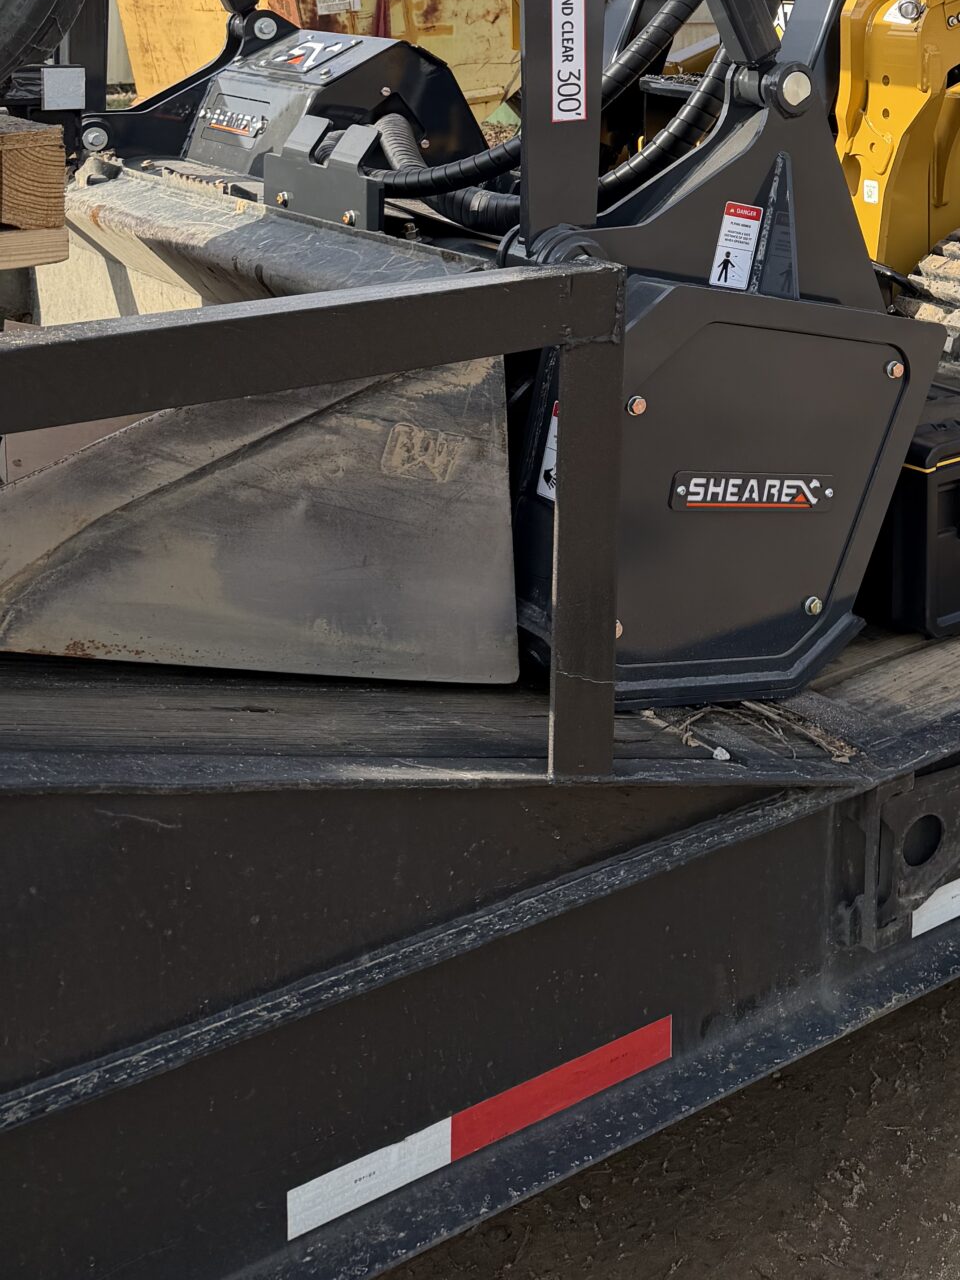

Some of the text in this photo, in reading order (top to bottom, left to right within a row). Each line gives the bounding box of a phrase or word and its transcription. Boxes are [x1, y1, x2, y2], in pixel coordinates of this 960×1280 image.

[561, 21, 574, 63] CLEAR
[557, 69, 582, 116] 300'
[736, 208, 757, 216] DANGER
[687, 477, 821, 505] SHEAREX
